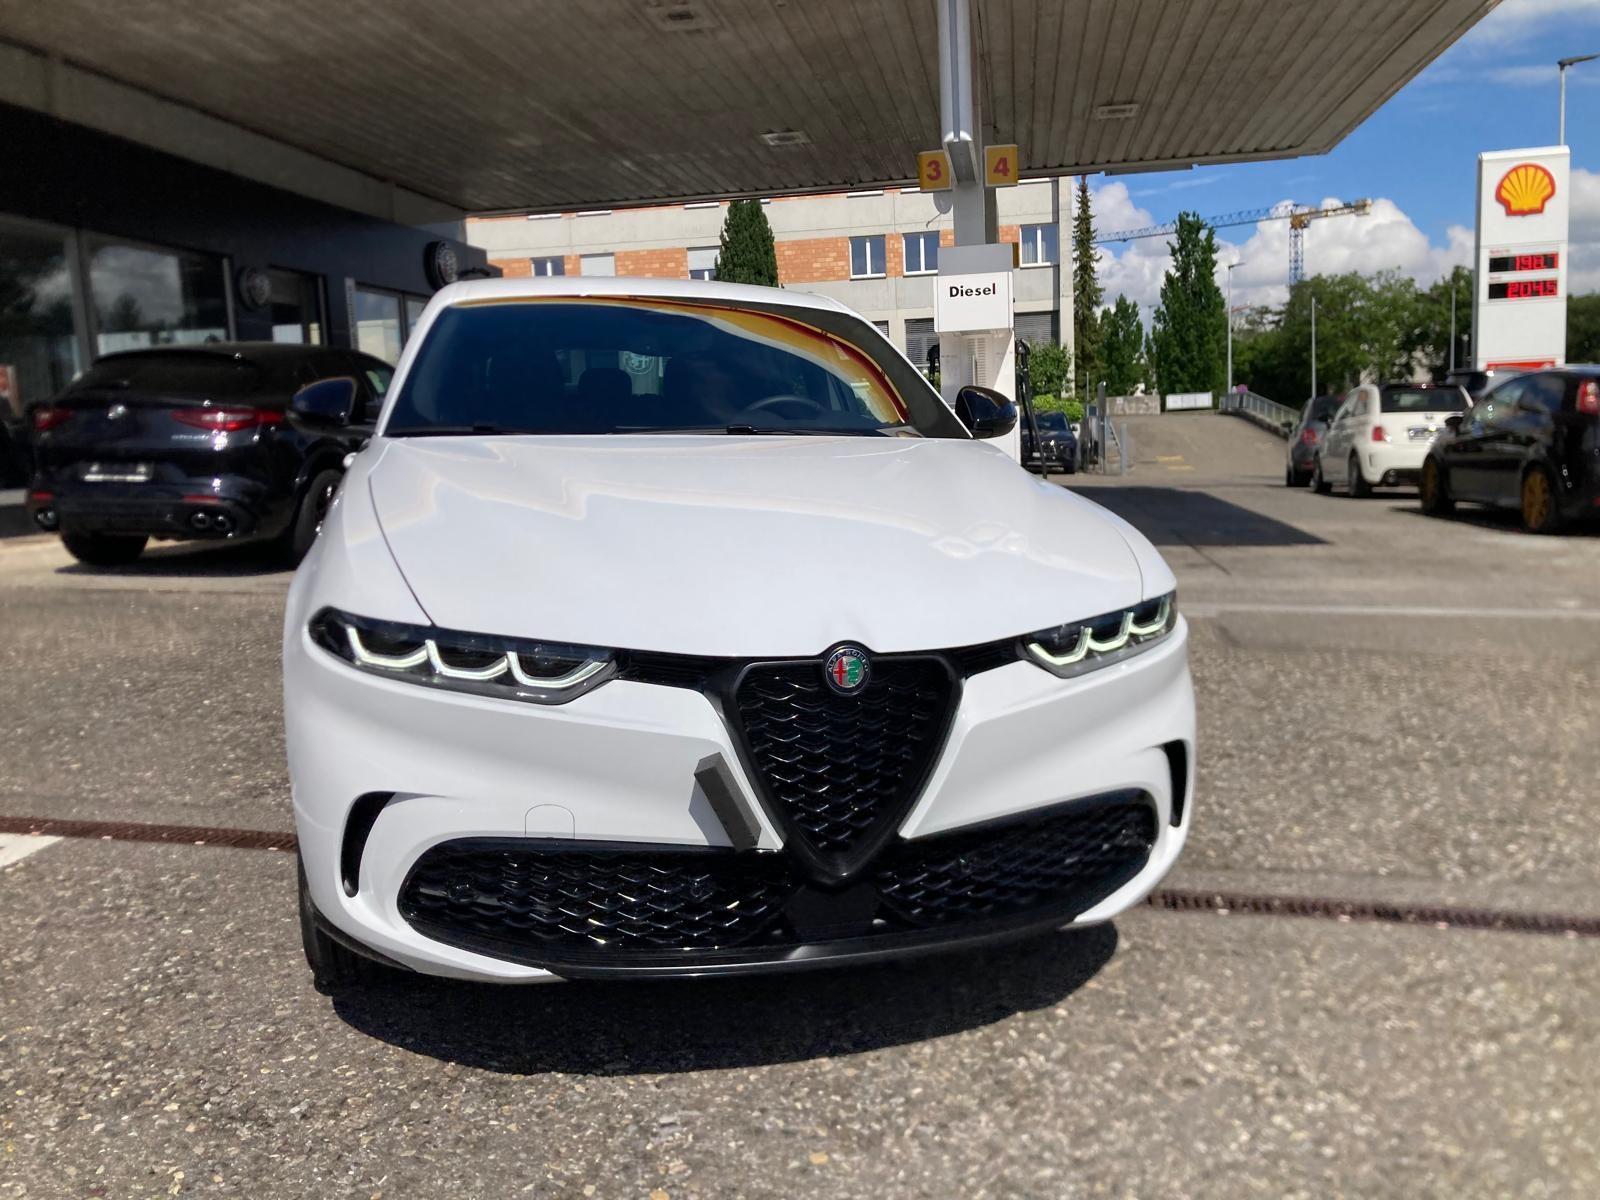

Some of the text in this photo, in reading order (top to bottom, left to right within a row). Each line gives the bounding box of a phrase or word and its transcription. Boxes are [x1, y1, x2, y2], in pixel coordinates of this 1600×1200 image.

[926, 160, 942, 181] 3
[993, 157, 1010, 176] 4
[949, 282, 996, 298] Diesel
